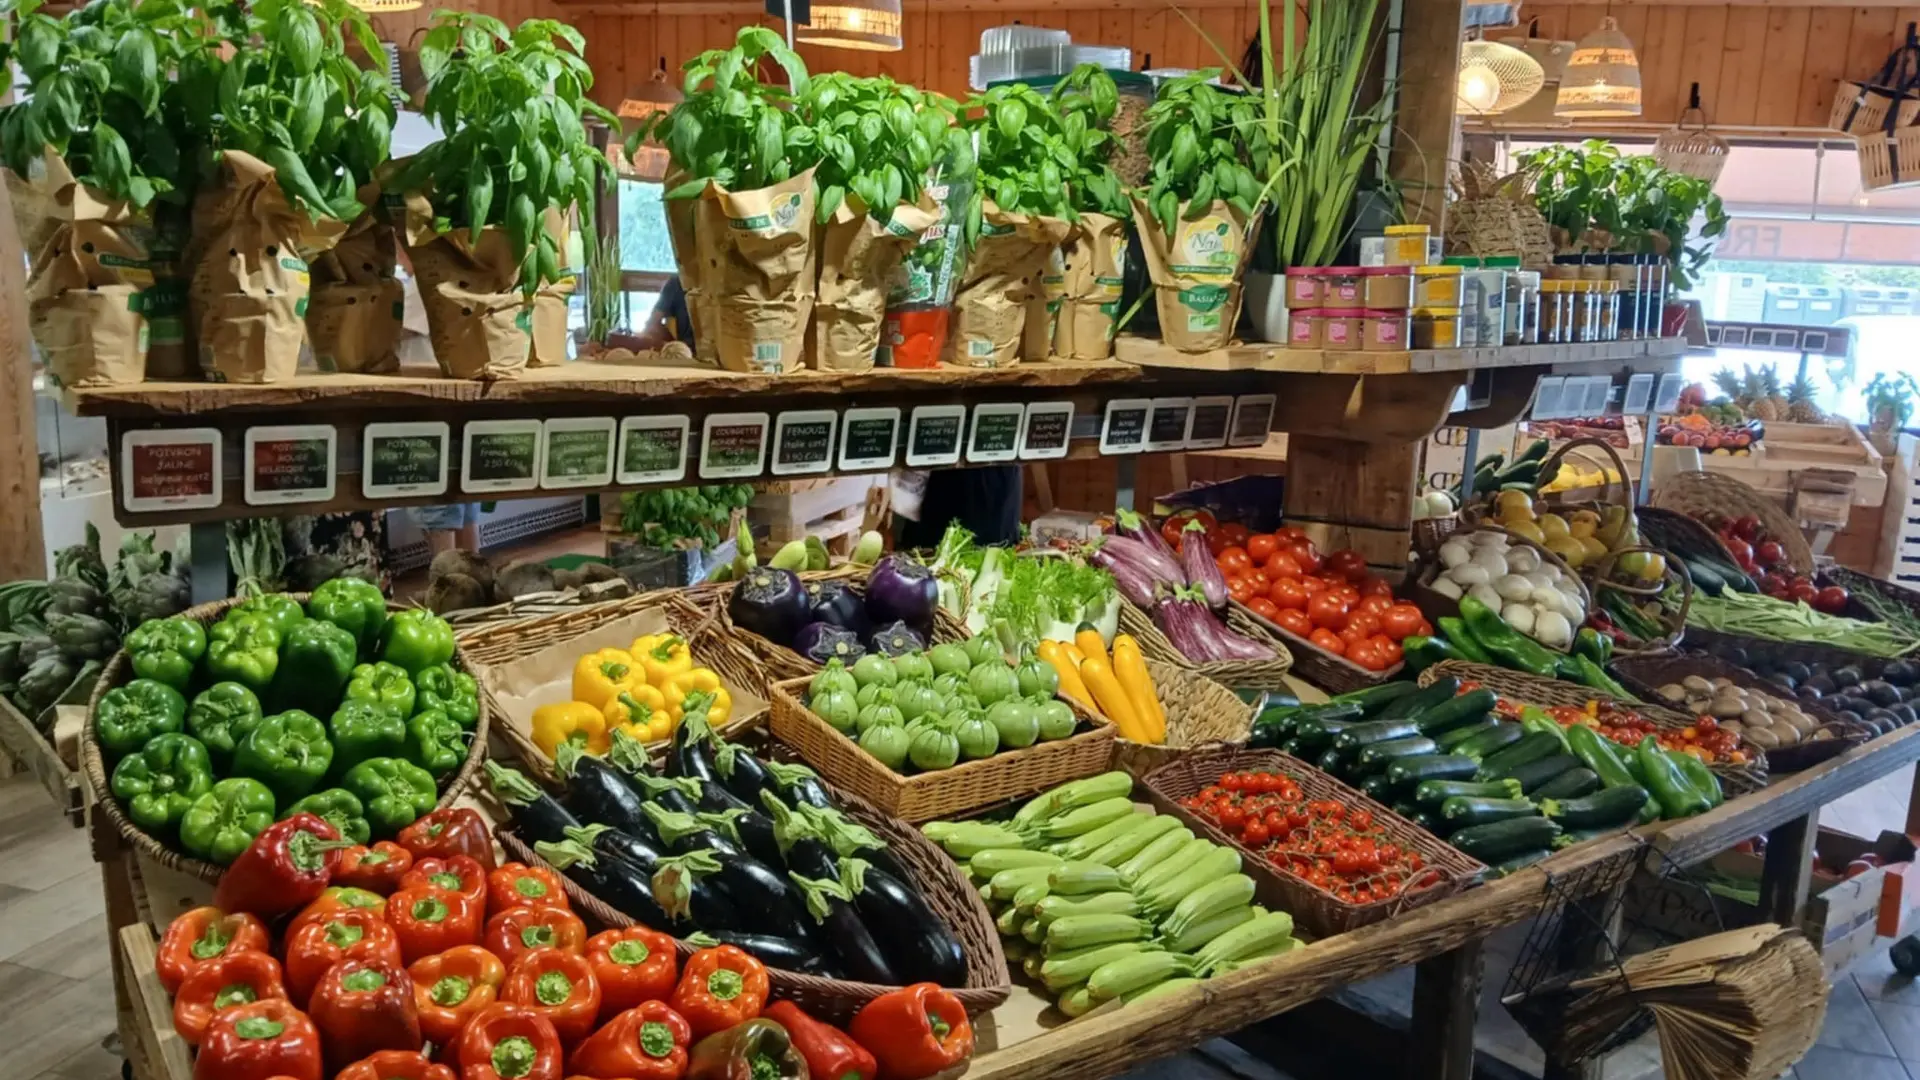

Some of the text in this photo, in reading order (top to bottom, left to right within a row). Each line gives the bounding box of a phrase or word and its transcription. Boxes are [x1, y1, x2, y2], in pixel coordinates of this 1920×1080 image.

[786, 425, 828, 437] FENOUIL
[385, 438, 432, 449] POIVRON
[147, 447, 202, 459] POIVRON
[156, 460, 196, 471] JAUNE
